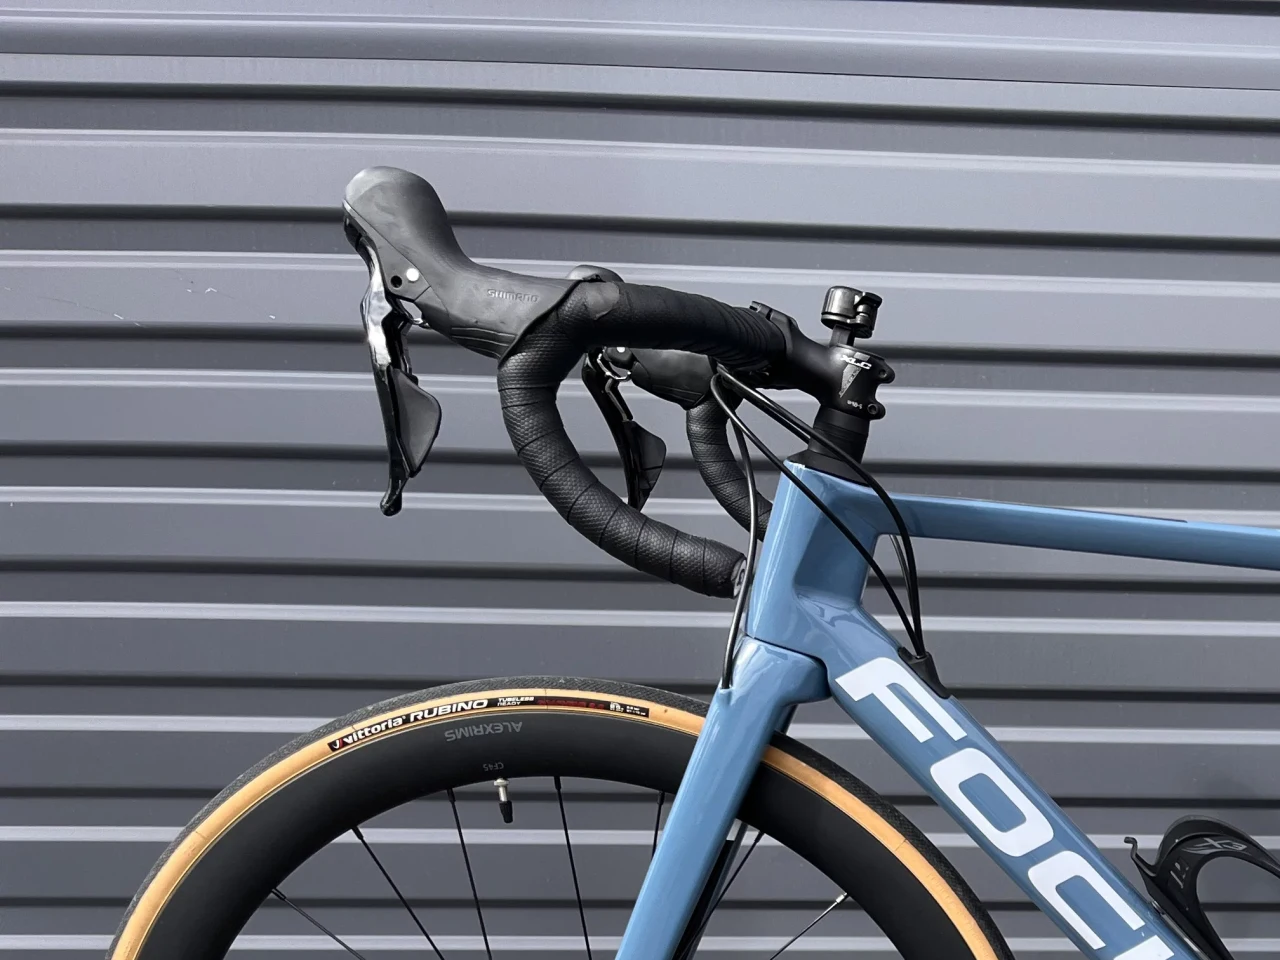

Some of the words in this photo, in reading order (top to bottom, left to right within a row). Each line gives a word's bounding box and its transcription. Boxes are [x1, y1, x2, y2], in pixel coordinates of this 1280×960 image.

[410, 698, 489, 723] RUBINO
[444, 721, 523, 742] ALEXRIMS
[482, 761, 505, 772] CF45
